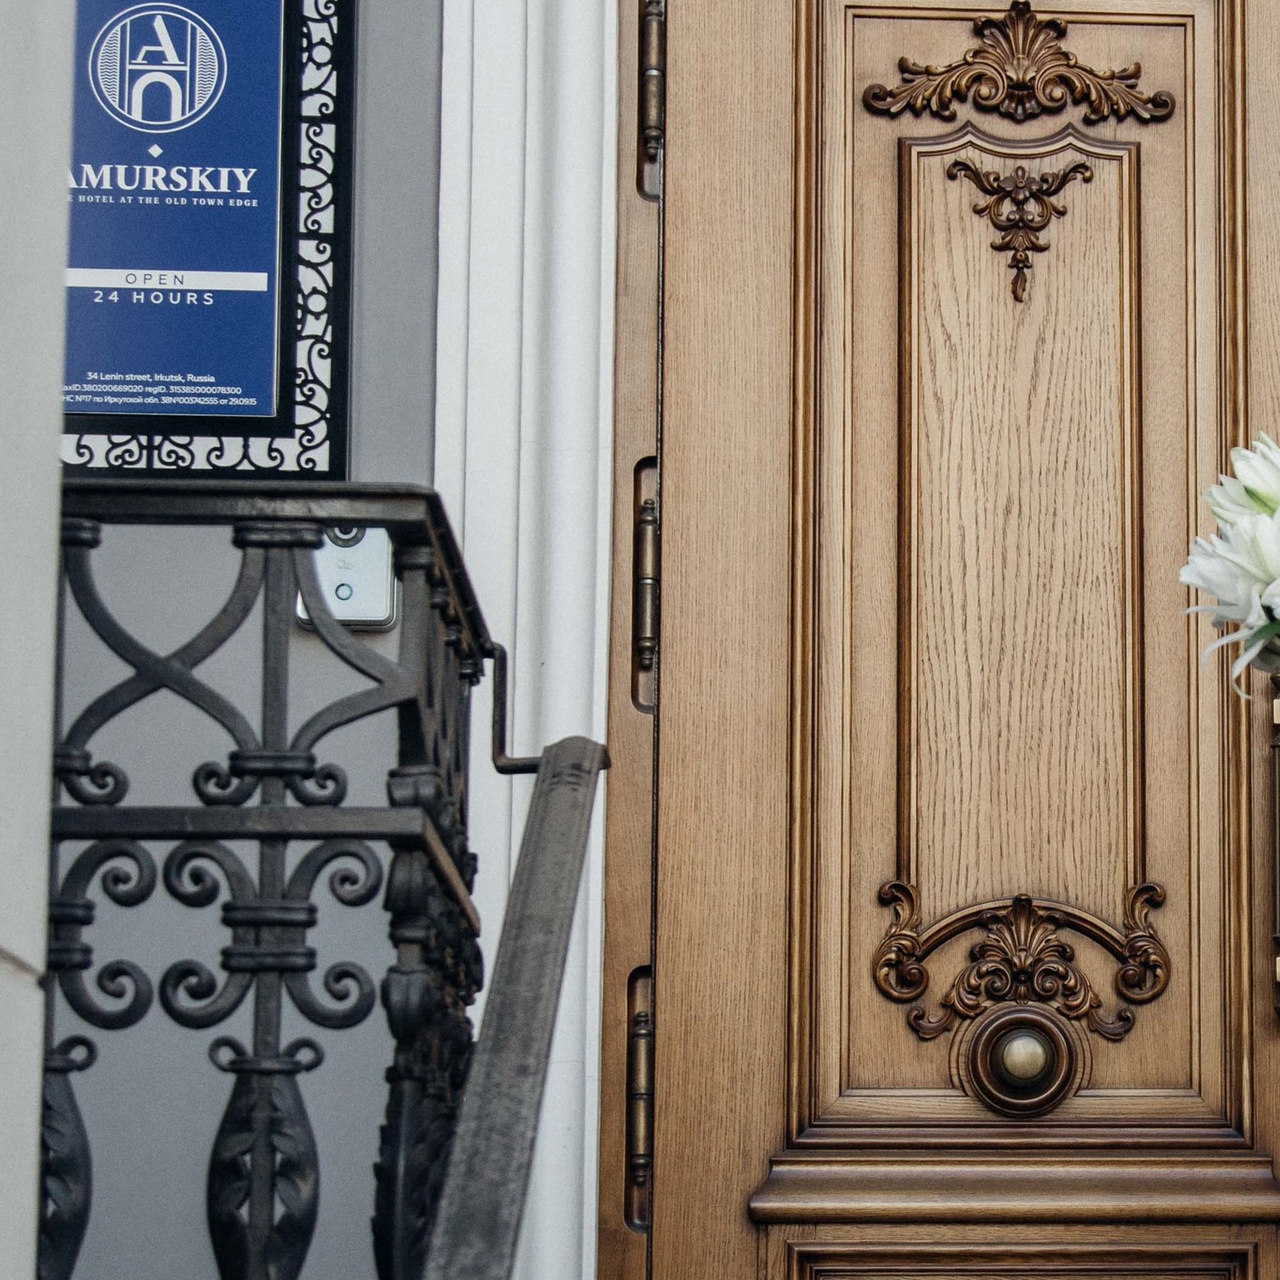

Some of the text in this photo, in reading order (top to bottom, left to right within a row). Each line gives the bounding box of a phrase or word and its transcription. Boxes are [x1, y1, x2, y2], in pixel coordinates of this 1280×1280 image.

[79, 195, 115, 204] HOTEL
[120, 196, 134, 204] AT
[138, 196, 160, 205] THE
[165, 197, 187, 206] OLD
[192, 198, 224, 206] TOWN
[229, 198, 259, 207] EDGE
[125, 273, 185, 286] OPEN
[93, 290, 214, 305] 24 HOURS
[86, 371, 216, 383] 34 Lenin street, Irkutsk, Russia
[62, 384, 144, 393] axID.380200669020
